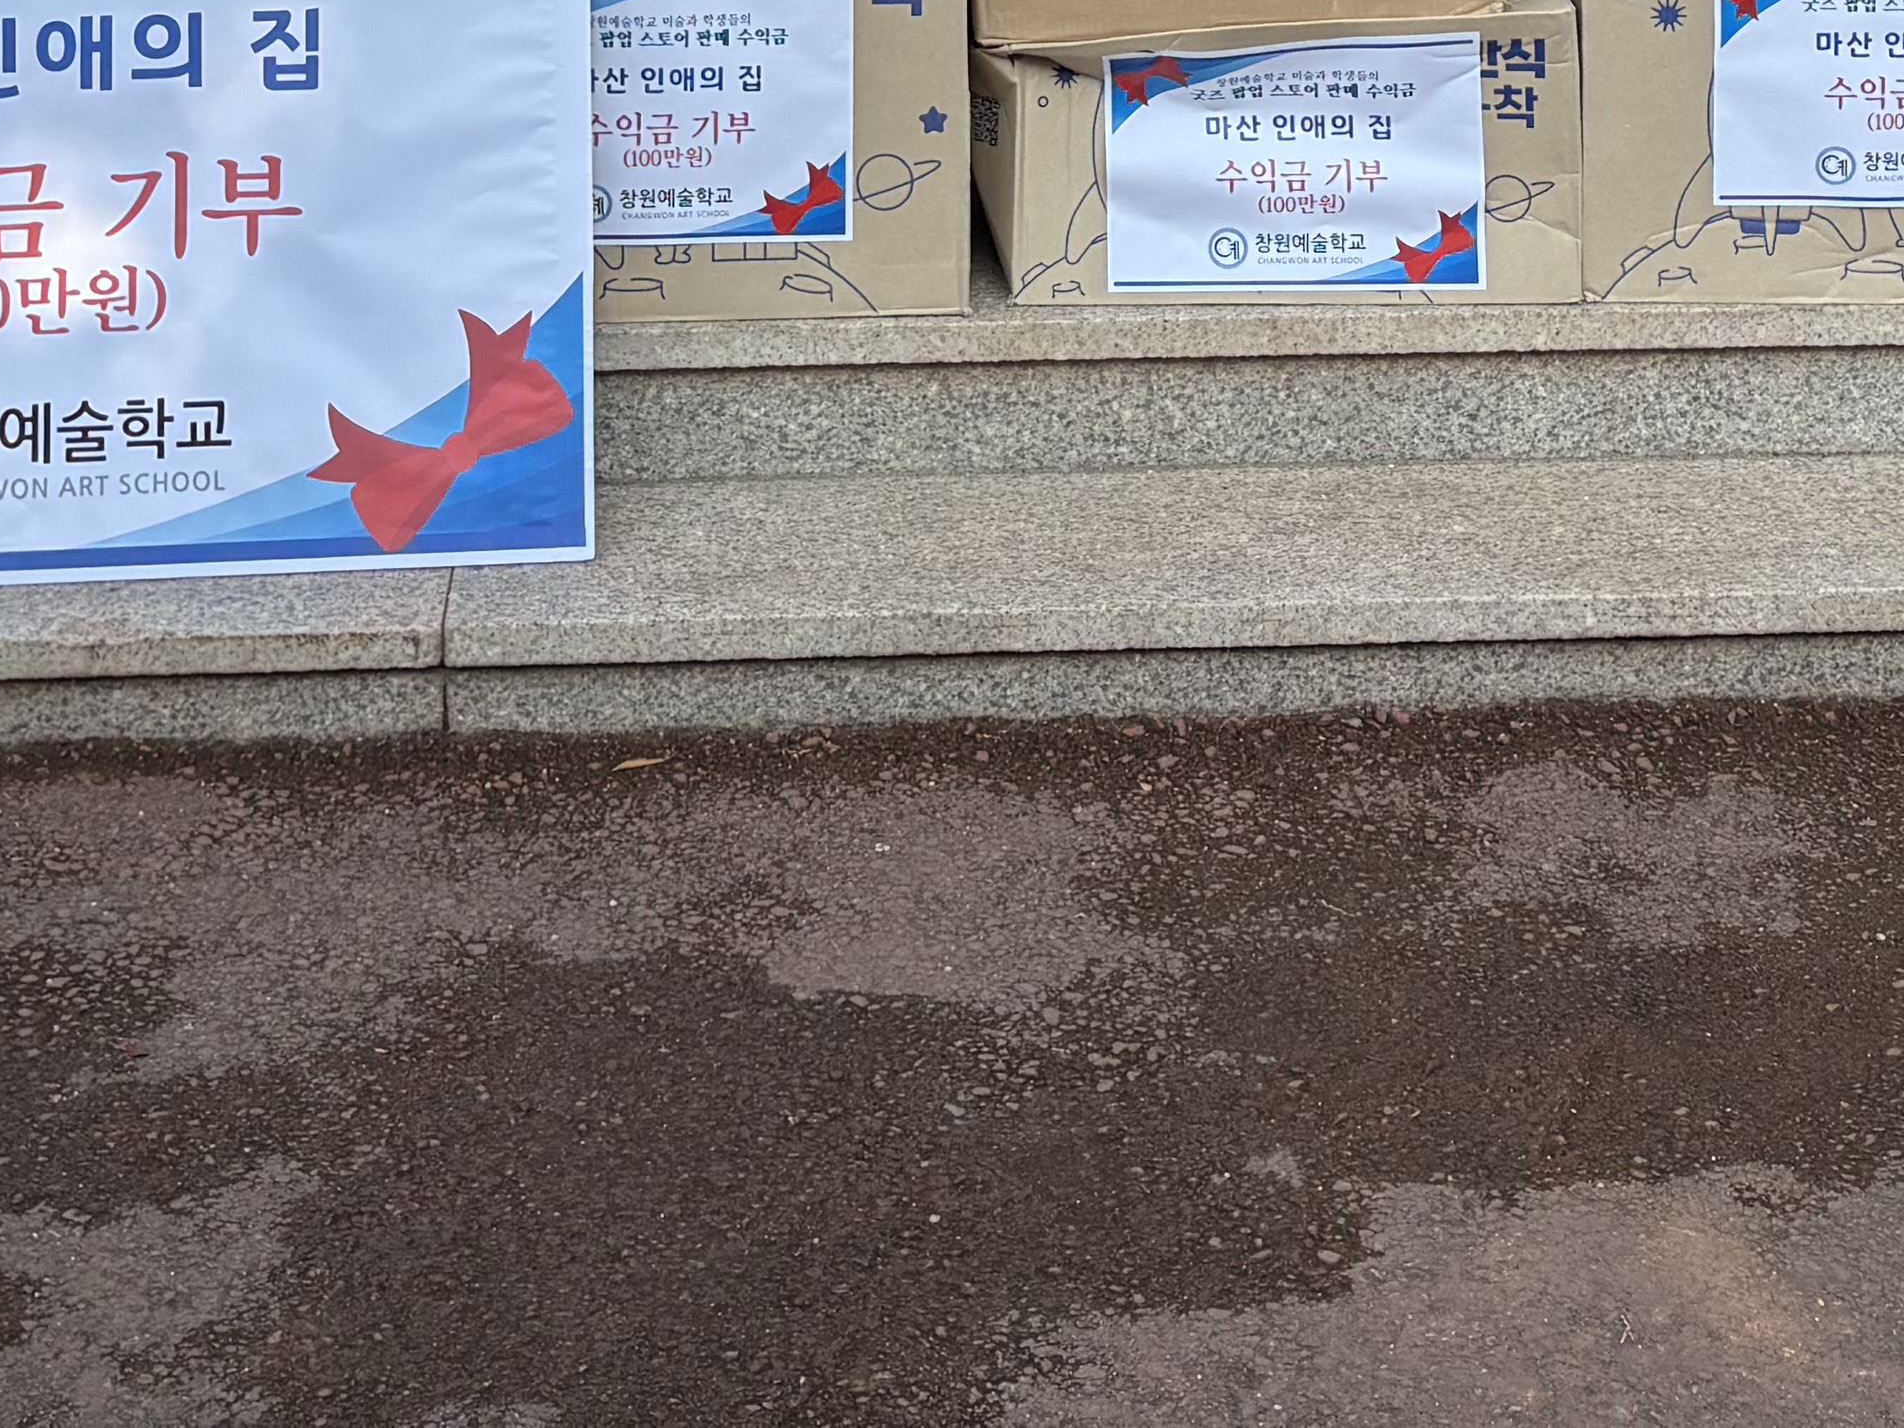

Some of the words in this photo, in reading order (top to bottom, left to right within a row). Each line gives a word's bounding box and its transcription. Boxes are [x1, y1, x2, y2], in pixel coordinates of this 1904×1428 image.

[251, 8, 319, 91] 집
[639, 30, 688, 48] 스토어
[697, 29, 729, 46] 판매
[737, 28, 788, 46] 수익금
[1817, 32, 1872, 57] 마산
[641, 67, 723, 93] 인애의
[739, 65, 761, 91] 집
[1232, 85, 1262, 99] 팝업
[1270, 83, 1318, 98] 스토어
[1327, 83, 1358, 98] 판매
[1366, 83, 1416, 99] 수익금
[692, 111, 755, 145] 기부
[1206, 115, 1261, 141] 마산
[1273, 115, 1353, 141] 인애의
[1369, 115, 1391, 140] 집
[624, 146, 711, 168] (100만원)
[1216, 159, 1312, 193] 수익금
[1325, 159, 1388, 193] 기부
[105, 152, 302, 259] 기부
[620, 188, 733, 209] 창원예술학교
[1259, 194, 1345, 214] (100만원)
[1256, 233, 1366, 253] 창원예술학교
[59, 475, 109, 497] ART
[120, 470, 225, 495] SCHOOL
